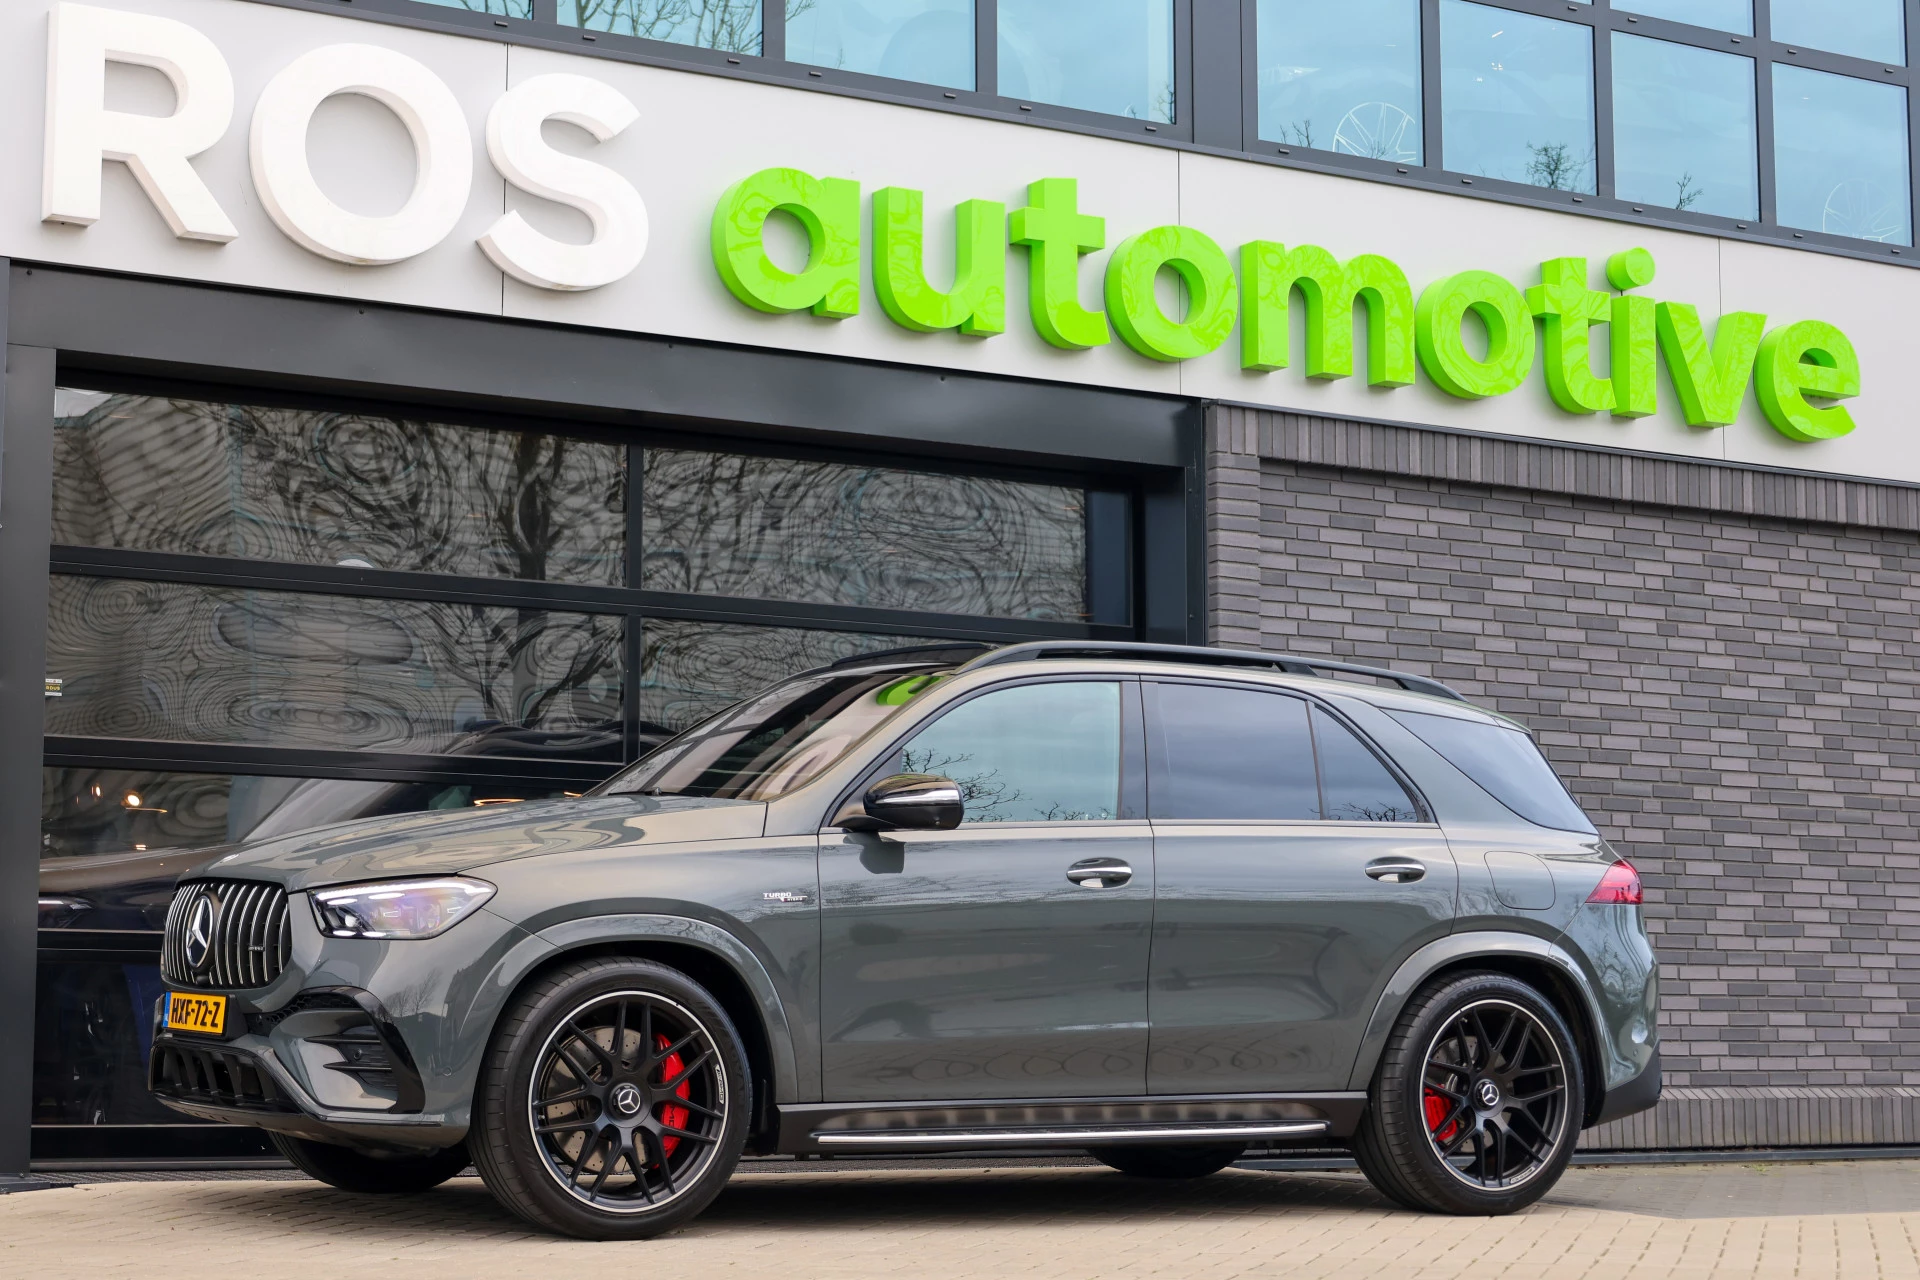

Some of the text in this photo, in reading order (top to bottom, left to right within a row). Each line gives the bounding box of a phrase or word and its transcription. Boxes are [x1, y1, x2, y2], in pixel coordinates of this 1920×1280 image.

[42, 1, 1861, 443] ROS automotive
[171, 998, 220, 1028] HXF-72-Z
